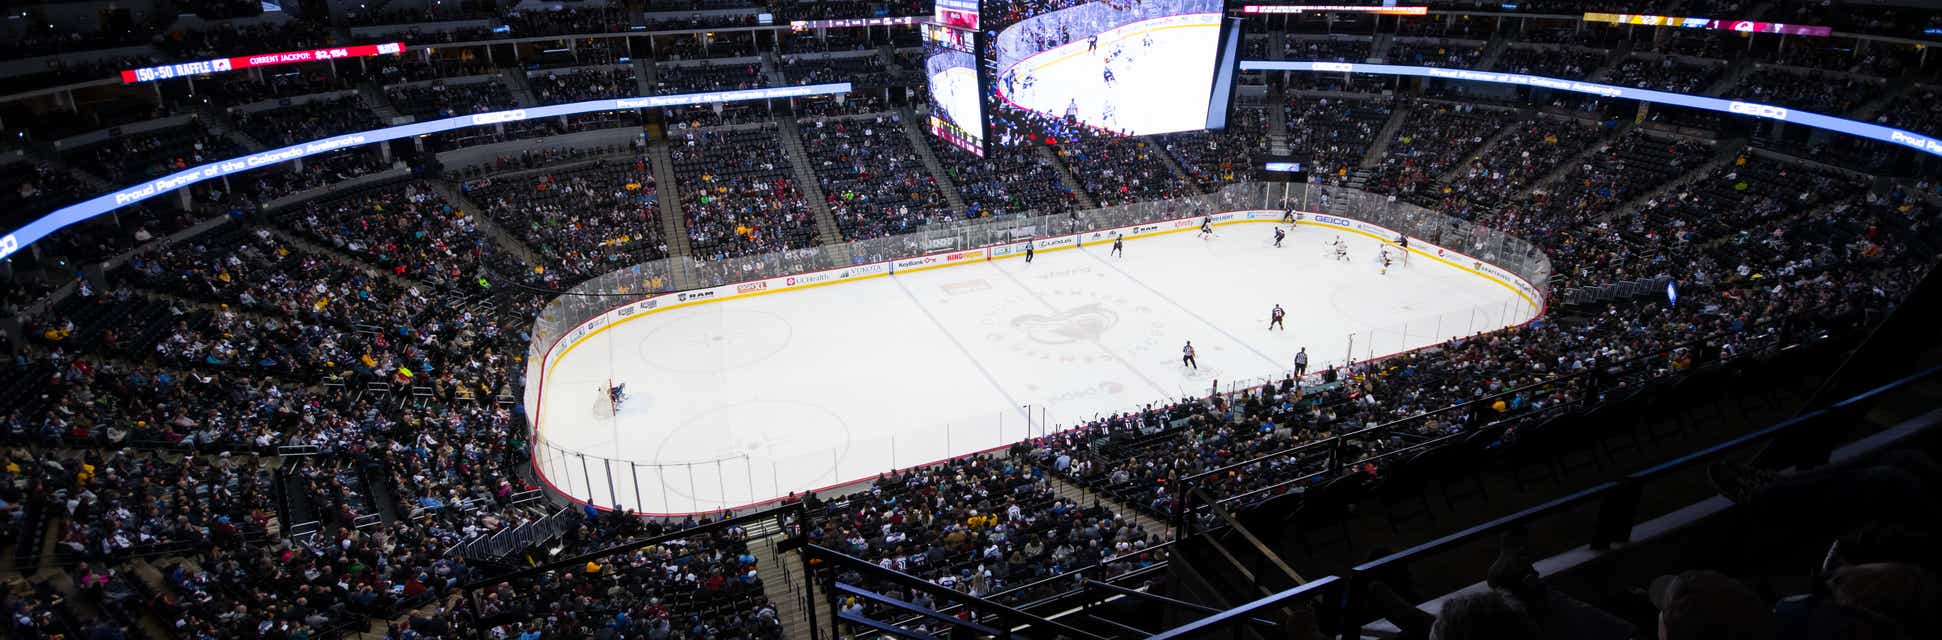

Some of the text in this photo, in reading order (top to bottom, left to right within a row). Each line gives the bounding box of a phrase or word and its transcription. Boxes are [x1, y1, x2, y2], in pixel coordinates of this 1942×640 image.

[250, 55, 279, 65] CURRENT
[175, 61, 211, 76] RAFFLE
[1729, 101, 1787, 120] GEICO
[1892, 131, 1925, 148] Proud
[115, 136, 366, 204] Proud Partner of the Colorado Avalanche
[1315, 215, 1350, 227] GEICO
[898, 258, 924, 269] KeyBank
[689, 290, 715, 300] RAM
